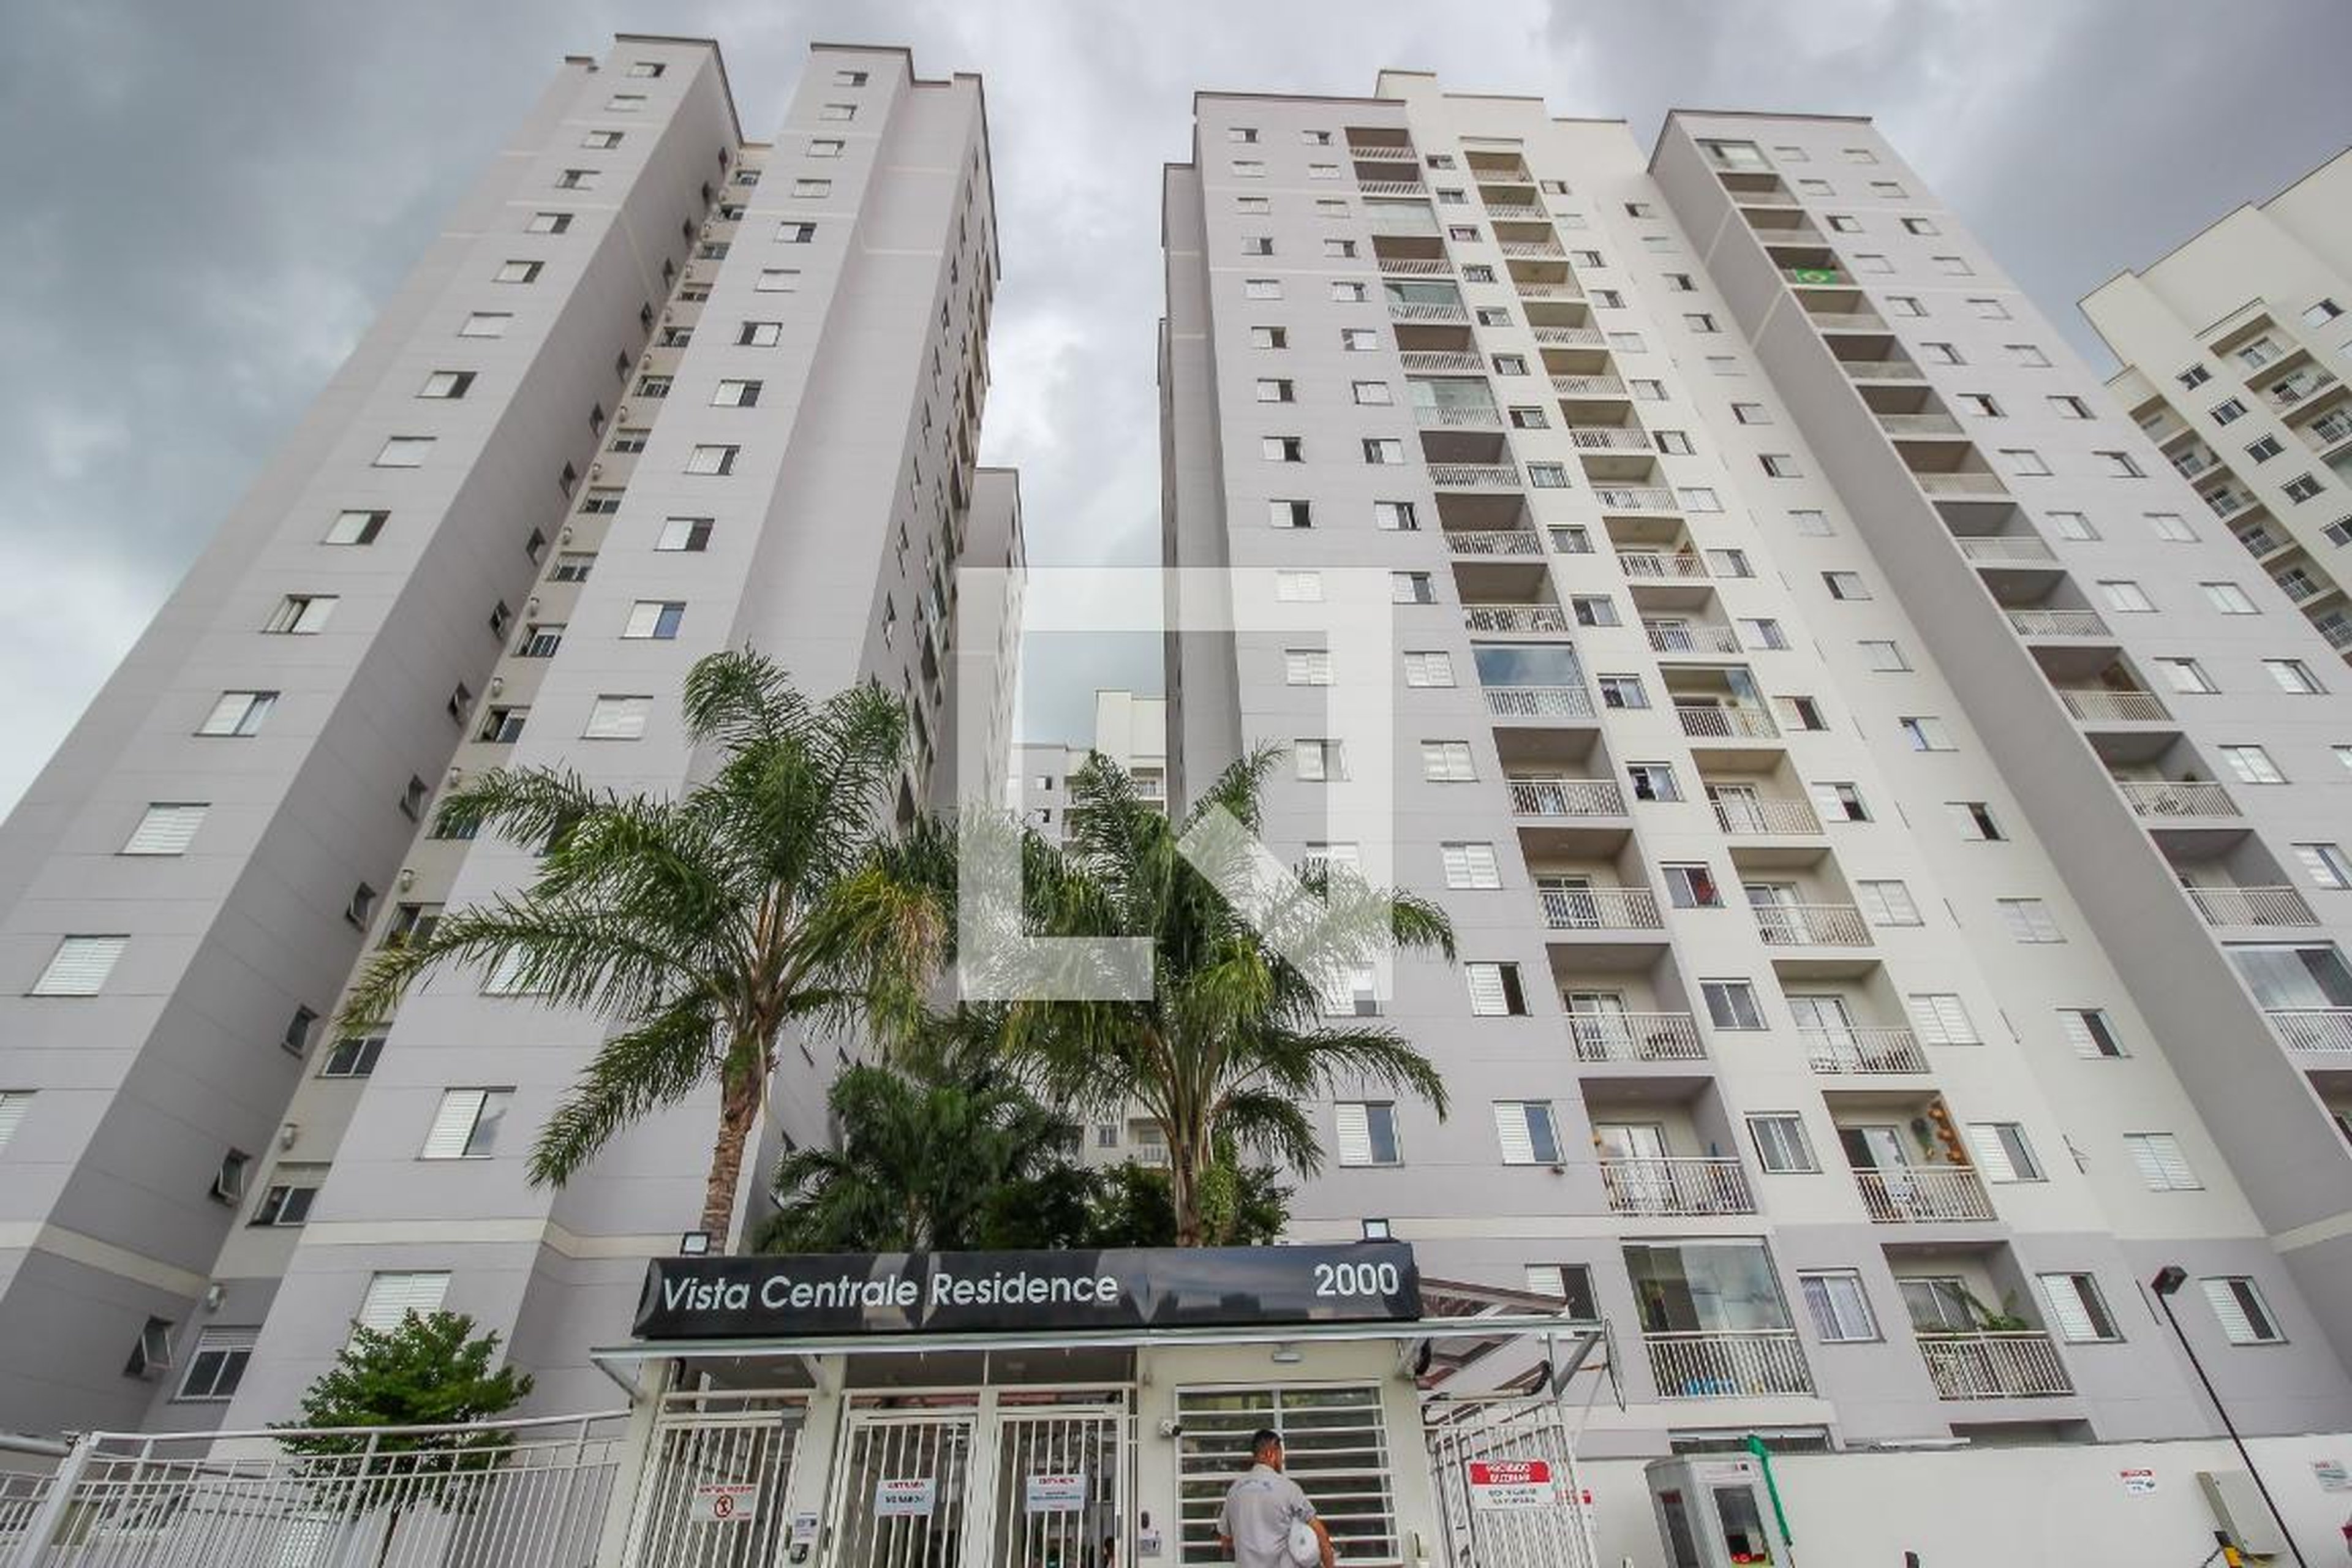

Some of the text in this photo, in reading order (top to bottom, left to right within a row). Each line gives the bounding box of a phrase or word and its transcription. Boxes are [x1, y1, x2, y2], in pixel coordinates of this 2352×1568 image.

[664, 1271, 1118, 1311] Vista Centrale Residence
[1314, 1263, 1399, 1295] 2000
